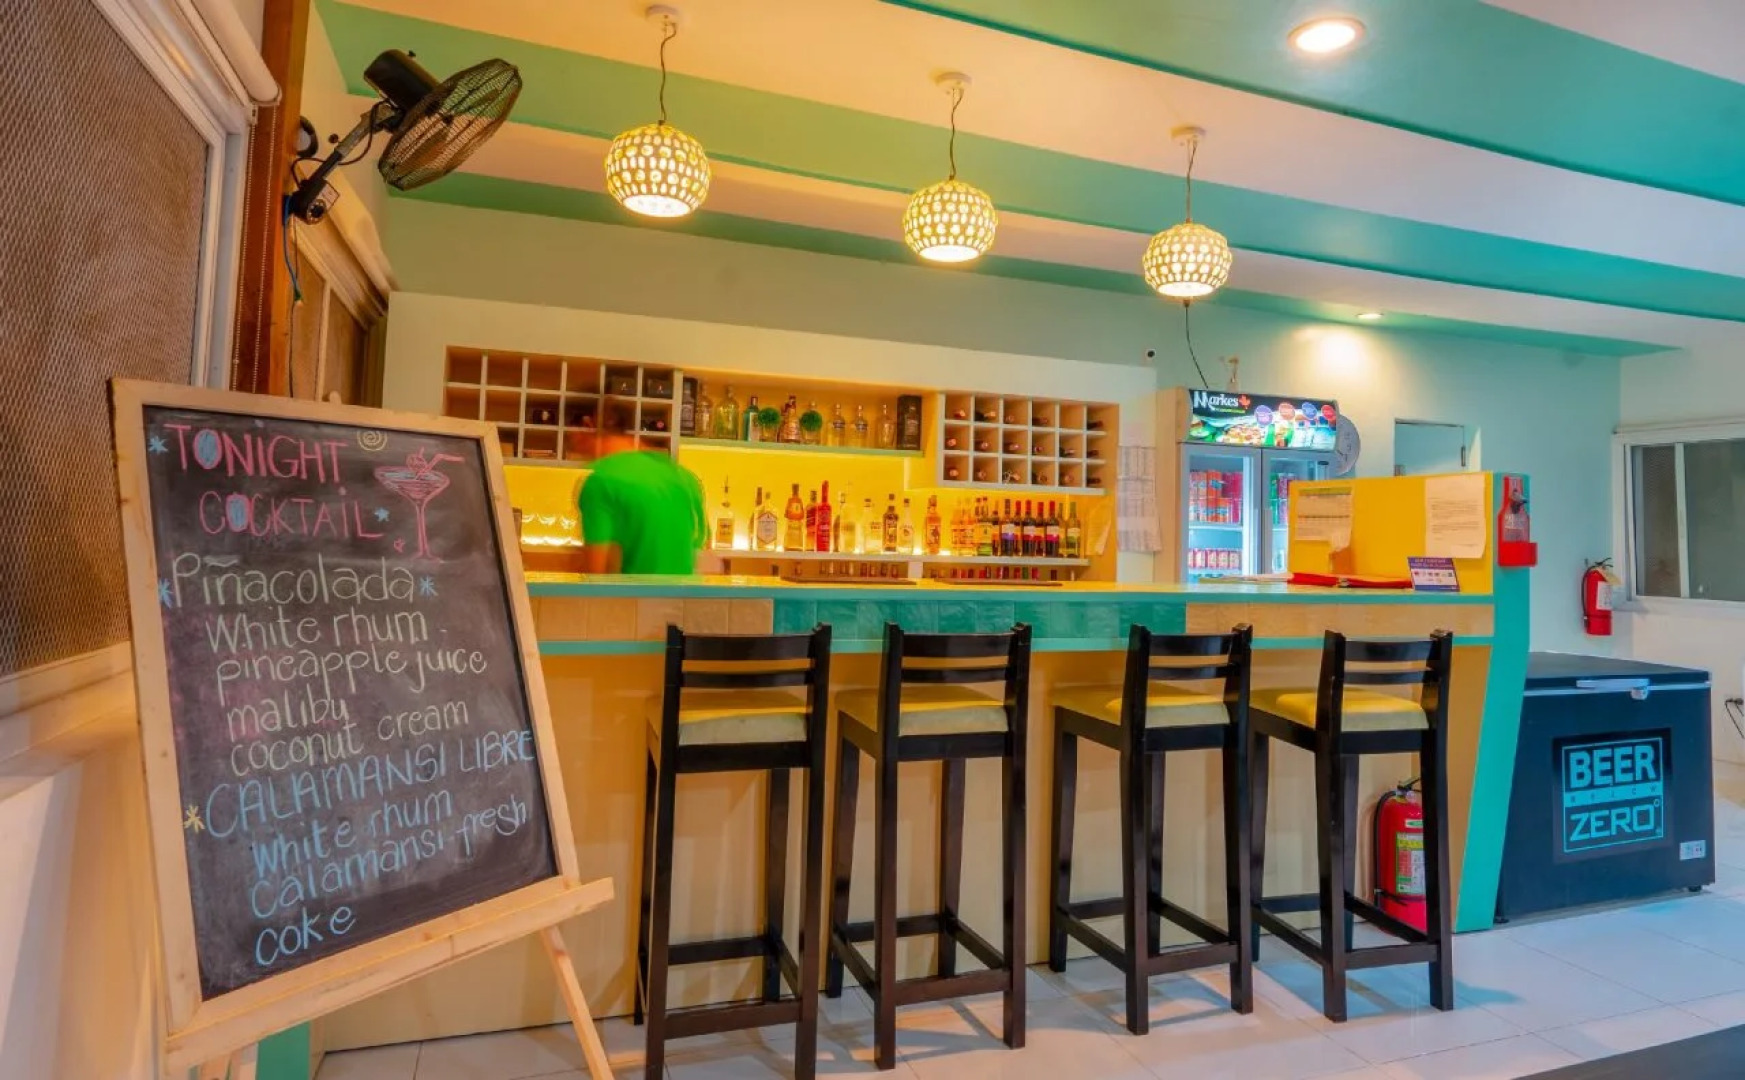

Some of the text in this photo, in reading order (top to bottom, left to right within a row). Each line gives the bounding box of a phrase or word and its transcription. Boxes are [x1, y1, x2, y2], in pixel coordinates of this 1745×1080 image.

[163, 423, 349, 484] TONIGHT
[200, 488, 385, 538] COCKTAIL
[205, 605, 429, 654] White rhum
[216, 642, 488, 708] pineapple juice
[227, 683, 350, 742] malibu
[231, 700, 470, 777] coconut cream
[205, 730, 535, 839] CALAMANSI LIBRE
[1569, 745, 1657, 789] BEER
[369, 790, 453, 838] rhum
[456, 794, 527, 856] fresh
